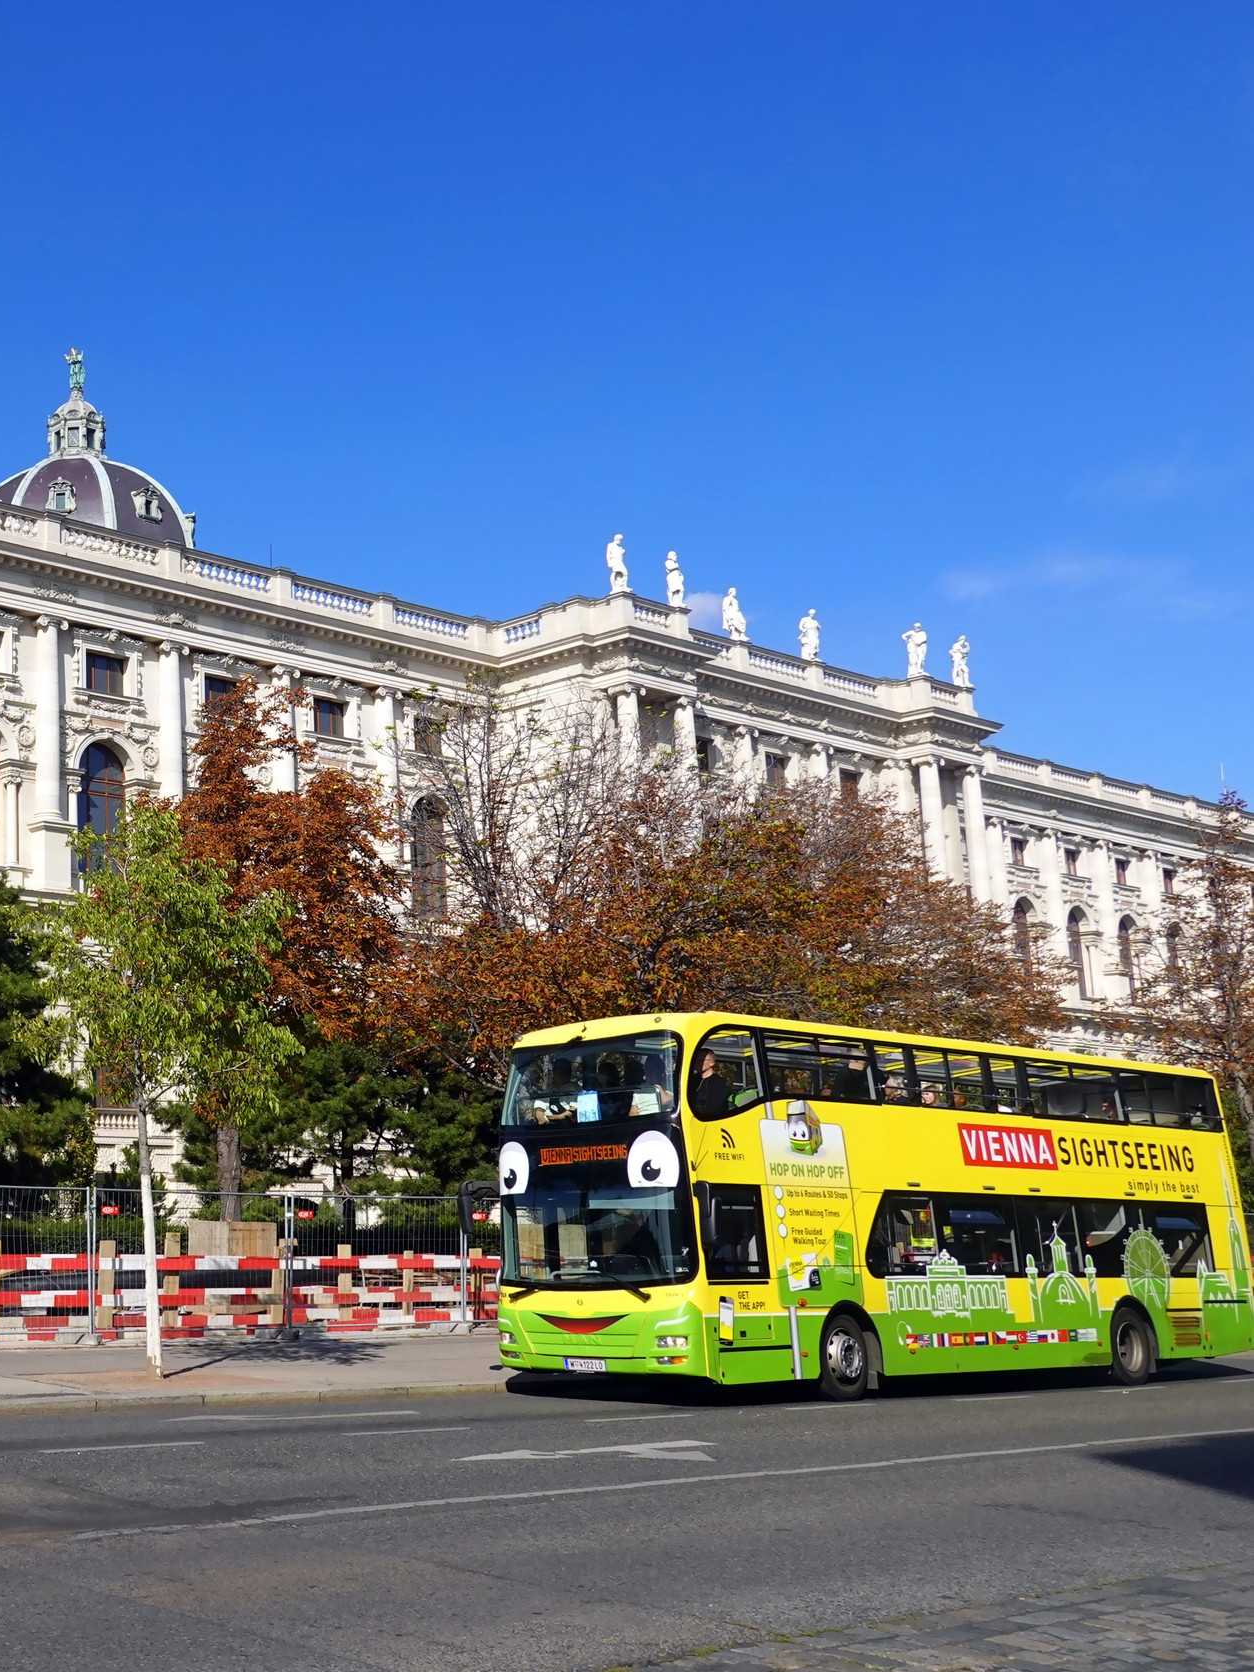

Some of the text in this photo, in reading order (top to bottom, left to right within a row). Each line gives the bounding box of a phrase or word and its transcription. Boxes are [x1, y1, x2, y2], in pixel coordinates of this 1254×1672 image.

[542, 1144, 627, 1163] VIENNA SIGHTSEEING
[961, 1129, 1195, 1172] VIENNA SIGHTSEEING
[714, 1152, 745, 1161] FREE WIFI
[769, 1163, 844, 1179] HOP ON HOP OFF
[1127, 1179, 1200, 1194] simply the best
[787, 1190, 793, 1198] Up
[805, 1190, 822, 1198] Routes
[834, 1191, 848, 1199] Stops
[789, 1208, 804, 1216] Short
[804, 1209, 824, 1218] Waiting
[791, 1227, 823, 1236] Free Guided
[793, 1237, 814, 1246] Walking
[816, 1237, 826, 1245] Tour
[738, 1291, 749, 1299] GET
[739, 1302, 766, 1310] THE APP!
